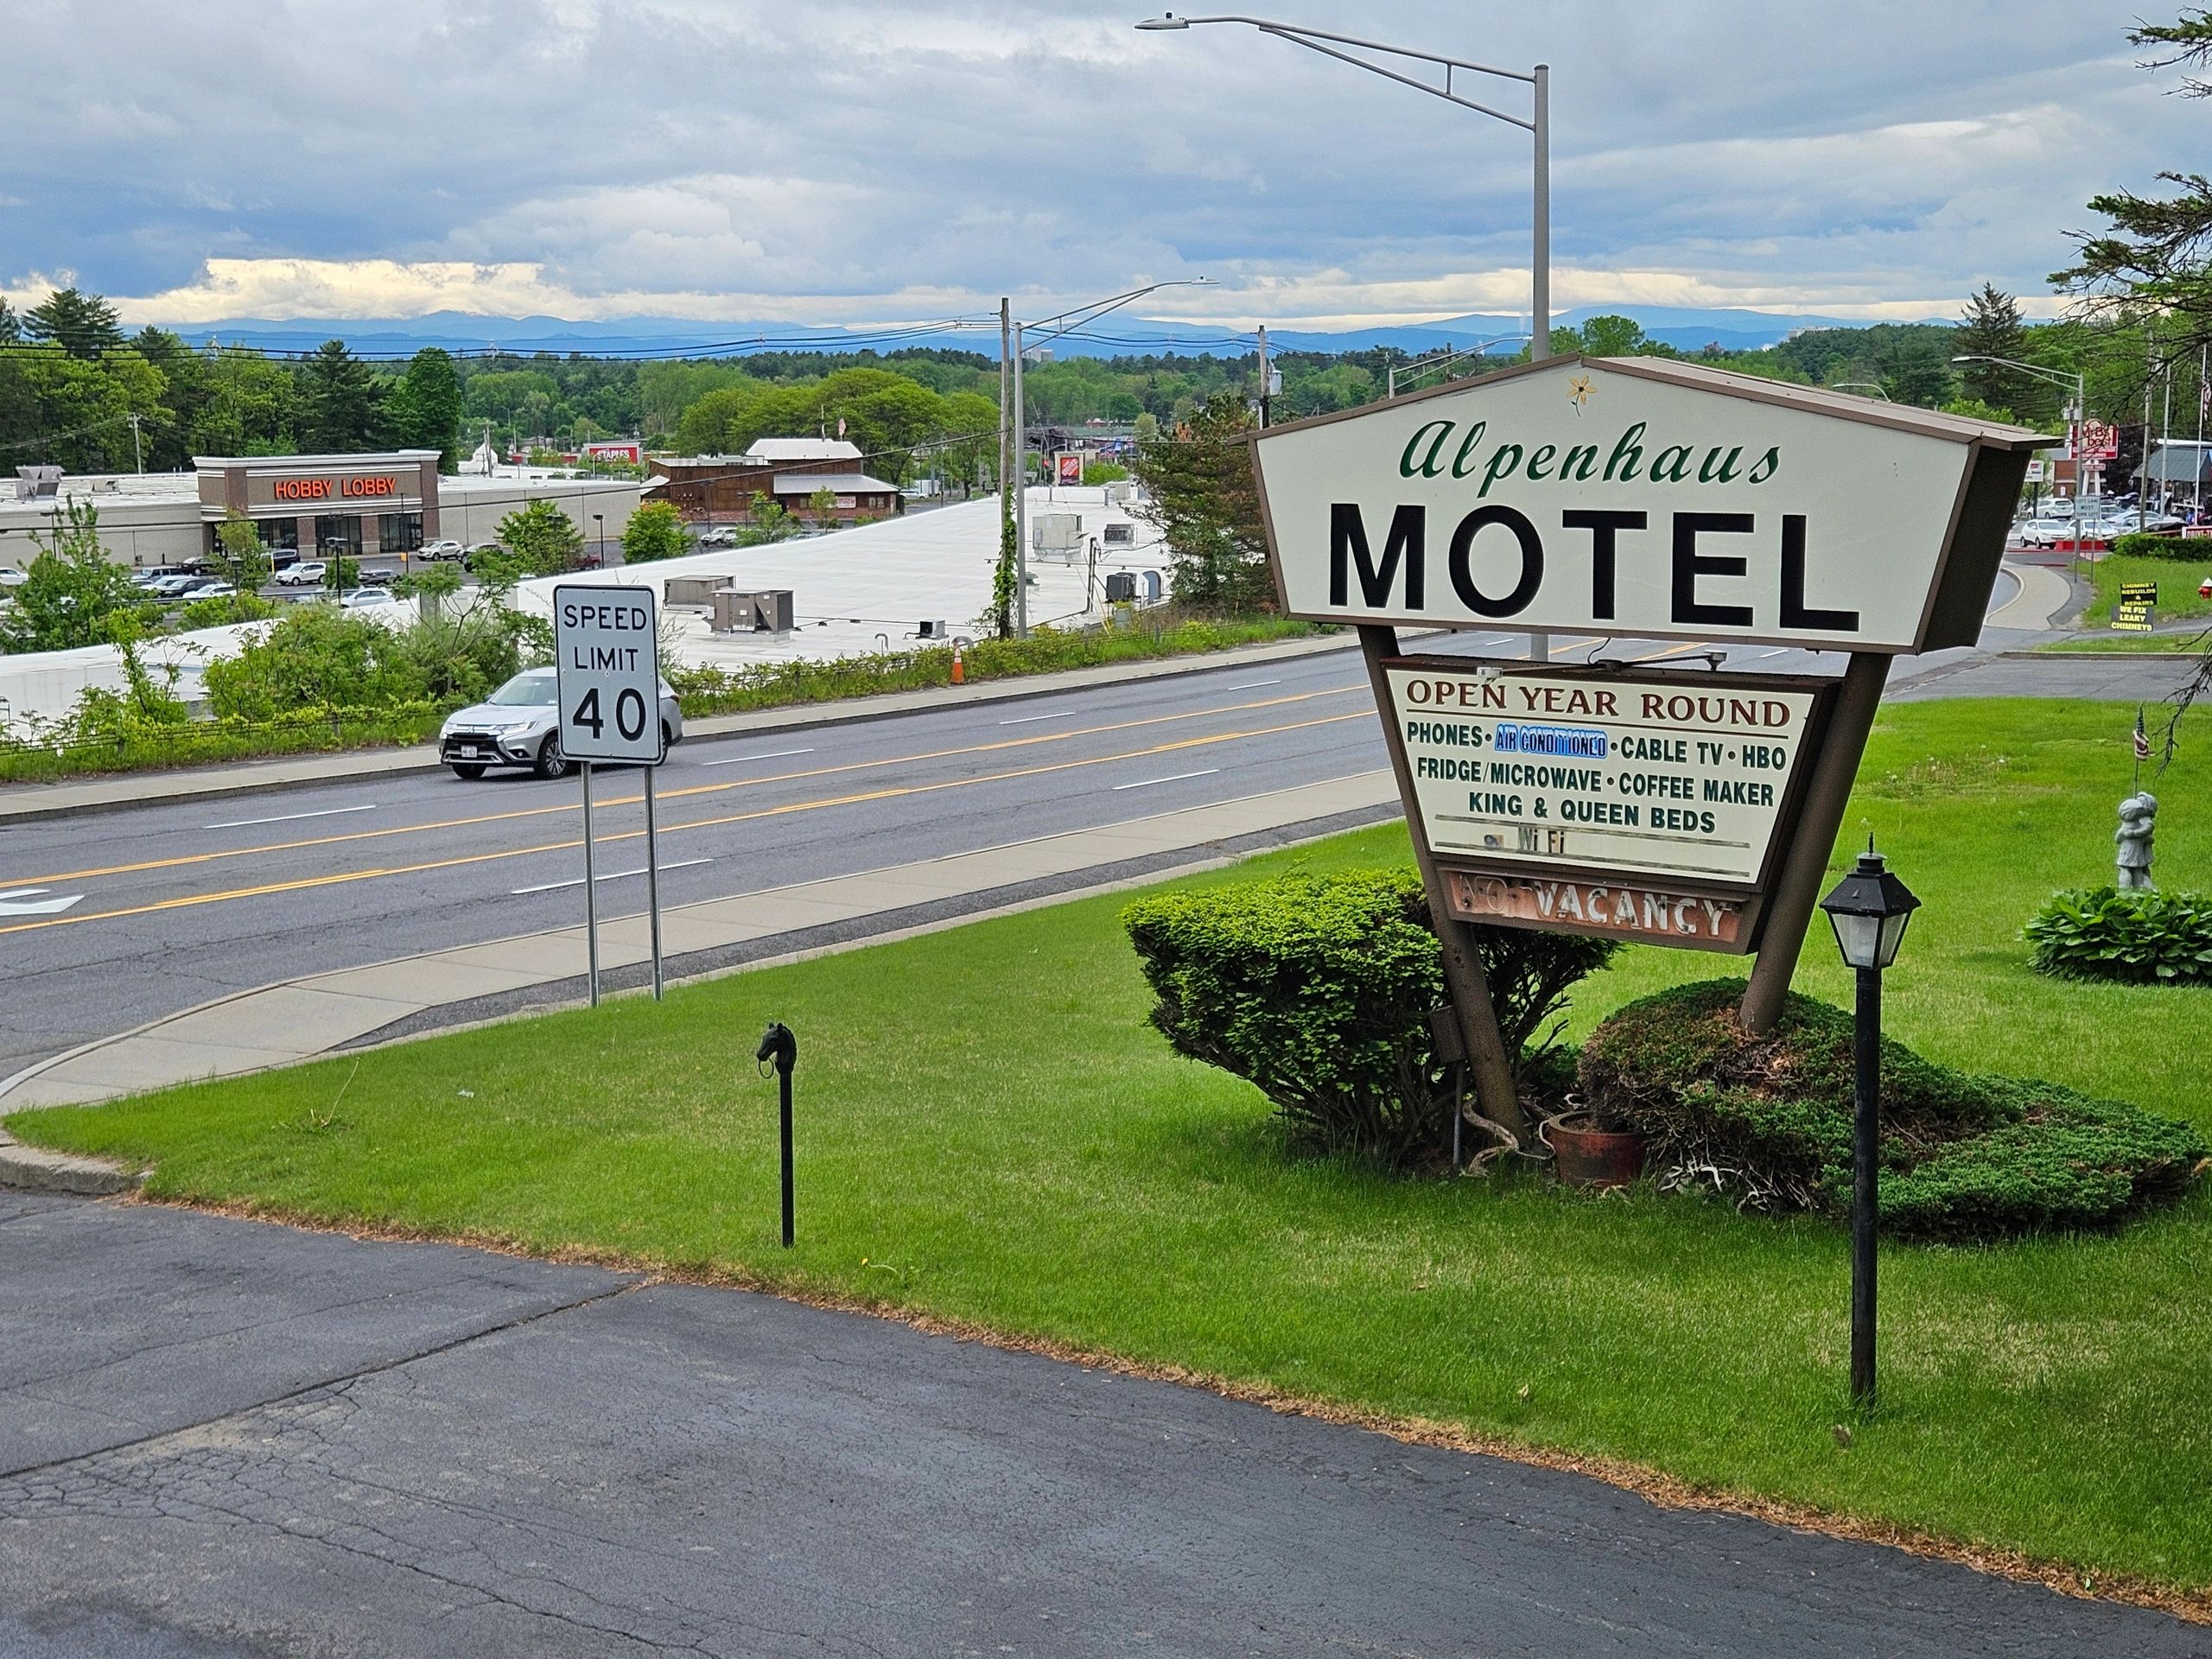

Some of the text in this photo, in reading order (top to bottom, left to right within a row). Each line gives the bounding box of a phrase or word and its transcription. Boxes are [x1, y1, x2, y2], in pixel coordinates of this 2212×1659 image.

[596, 449, 630, 461] STAPLES
[1398, 420, 1781, 499] Alpenhaus
[274, 477, 396, 499] HOBBY LOBBY
[1328, 502, 1860, 632] MOTEL
[563, 604, 647, 631] SPEED
[2111, 622, 2152, 632] CHIMNEYS
[2120, 613, 2145, 622] LEAKY
[574, 646, 639, 671] LIMIT
[572, 688, 646, 741] 40
[1407, 679, 1791, 728] OPEN YEAR ROUND
[1407, 721, 1787, 771] PHONES AIR CONDITIONED CABLE TV HBO
[1619, 772, 1694, 800] COFFEE
[1703, 779, 1774, 807] MAKER
[1469, 791, 1715, 834] KING & QUEEN BEDS
[1533, 880, 1731, 937] VACANCY
